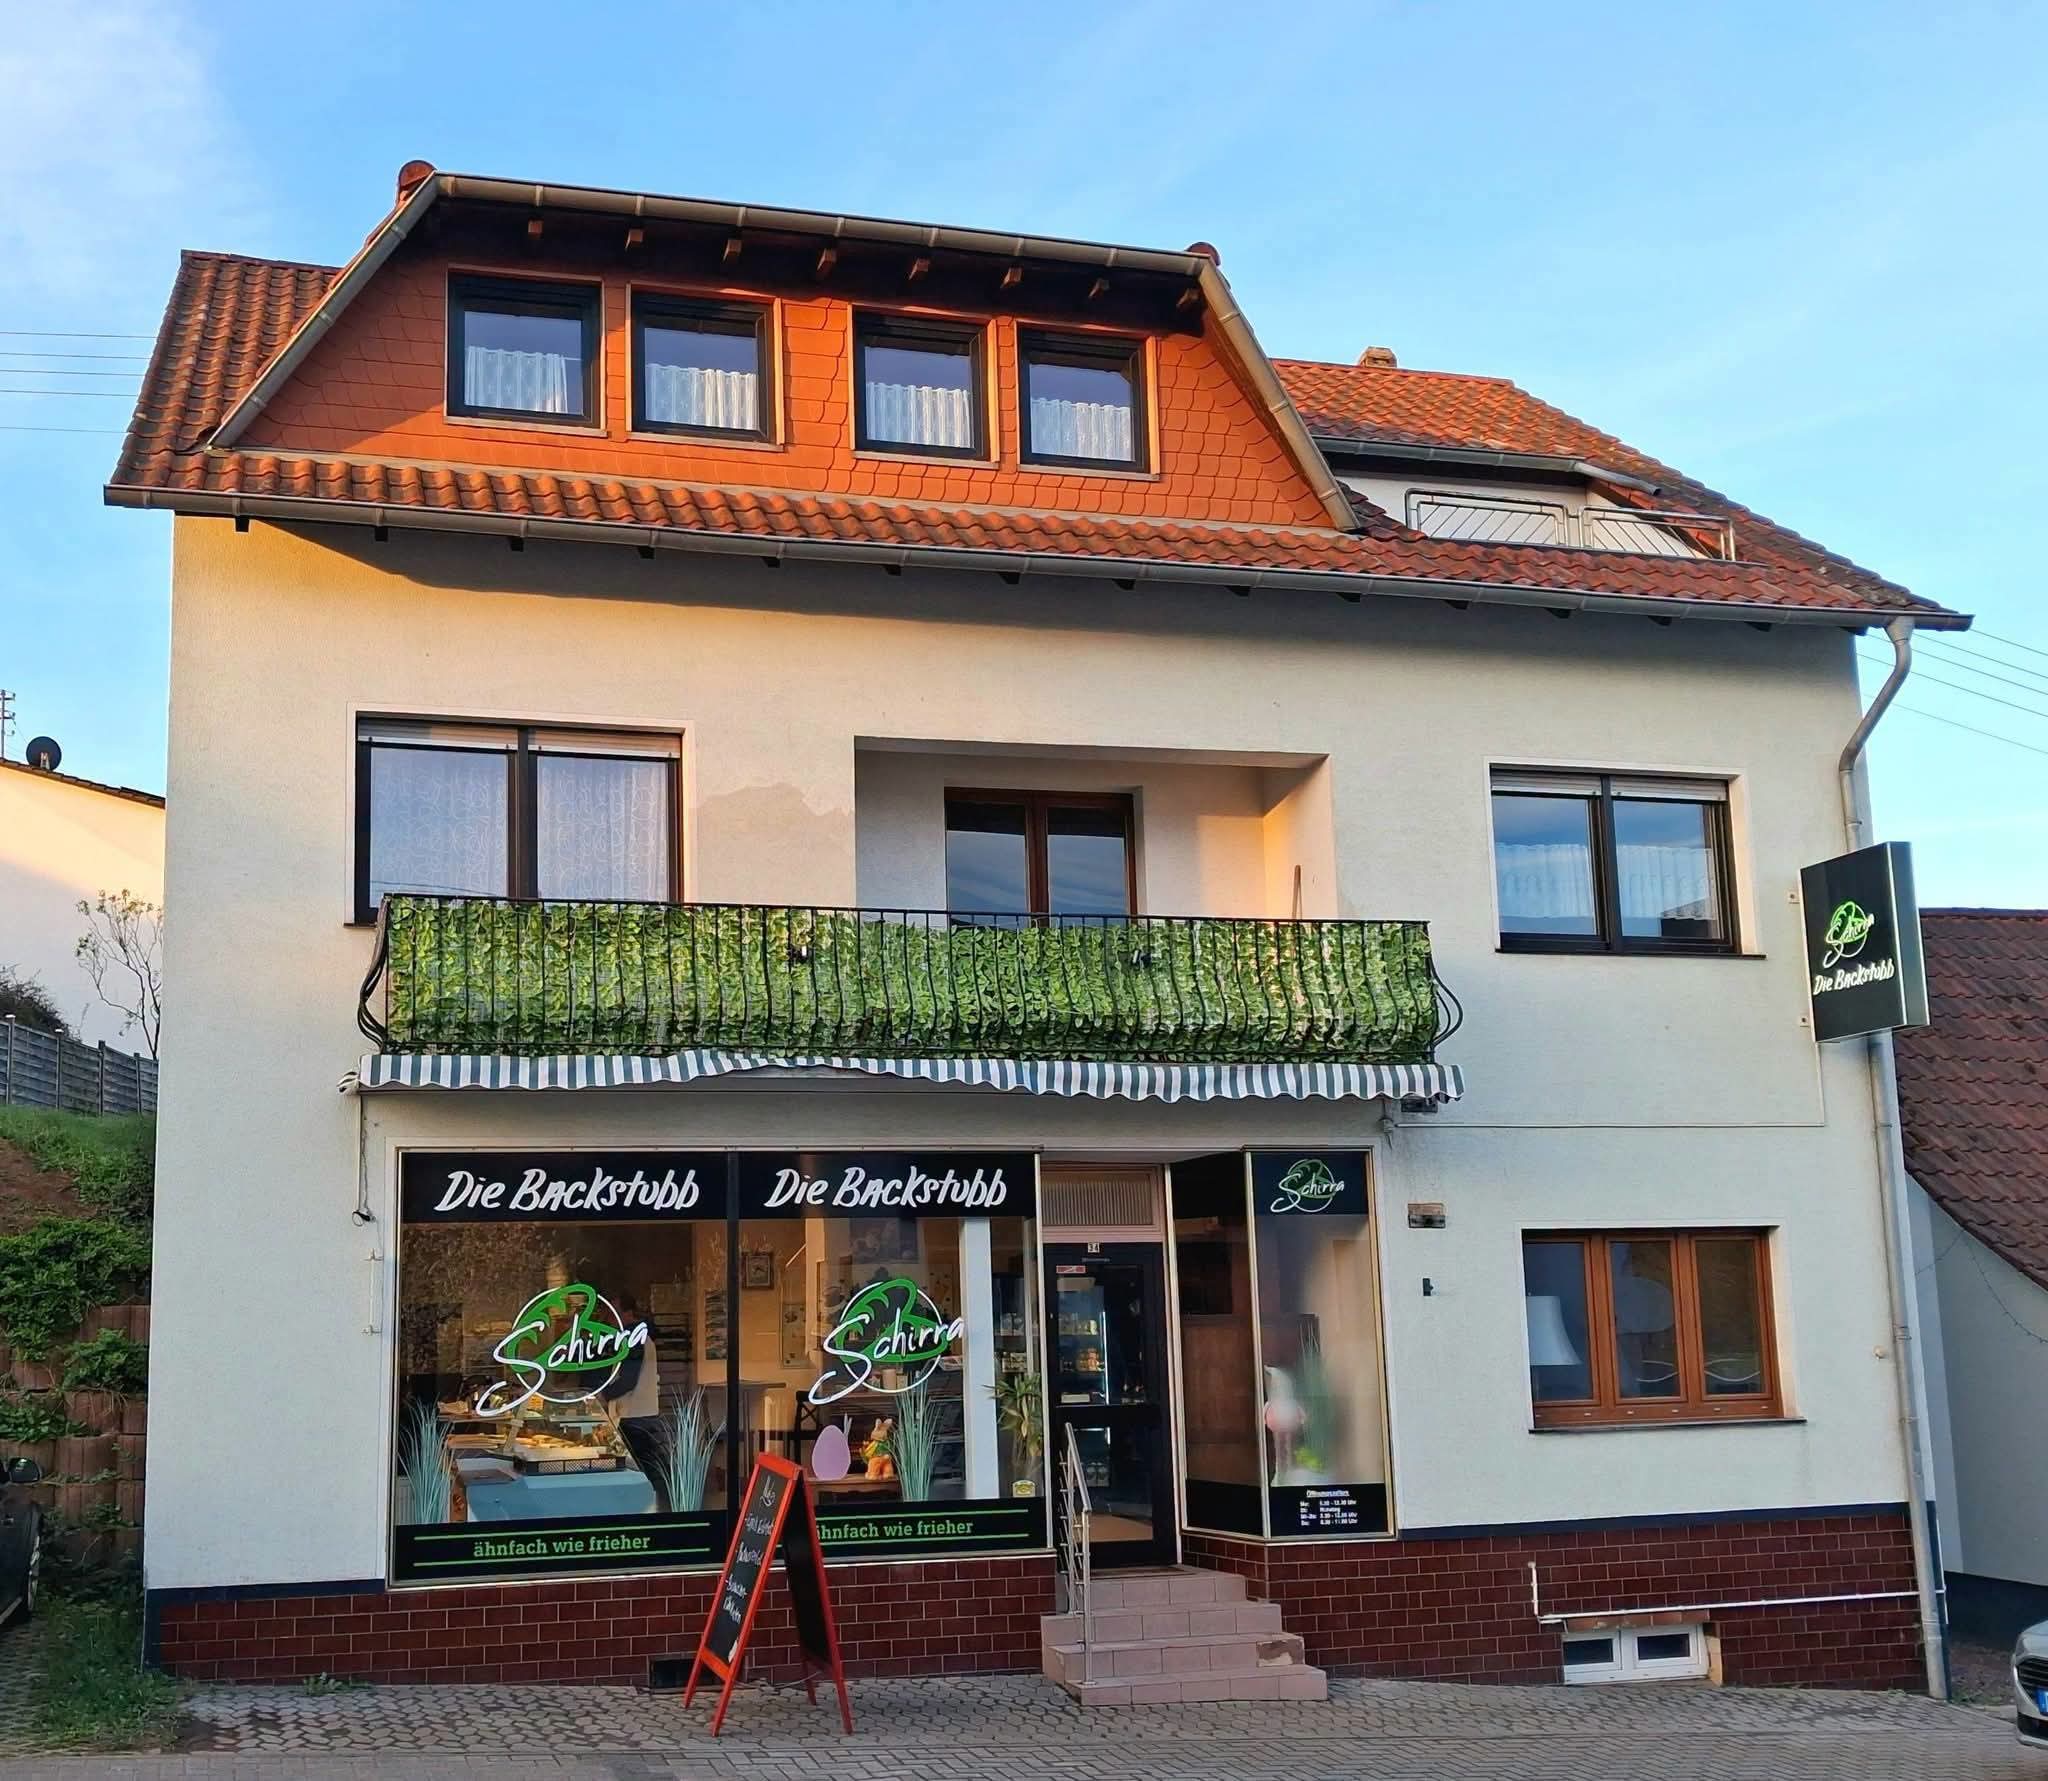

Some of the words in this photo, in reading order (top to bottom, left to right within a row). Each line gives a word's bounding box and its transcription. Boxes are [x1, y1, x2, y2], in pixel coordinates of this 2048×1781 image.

[1813, 975, 1833, 995] Die
[434, 1170, 505, 1211] Die
[764, 1168, 829, 1207] Die
[1270, 1172, 1345, 1213] Schirra
[475, 1313, 649, 1417] Schirra
[808, 1307, 965, 1405] Schirra
[473, 1539, 548, 1557] ähnfach
[552, 1537, 585, 1553] wie
[589, 1534, 651, 1551] frieher
[883, 1521, 913, 1538] wie
[916, 1519, 974, 1536] frieher
